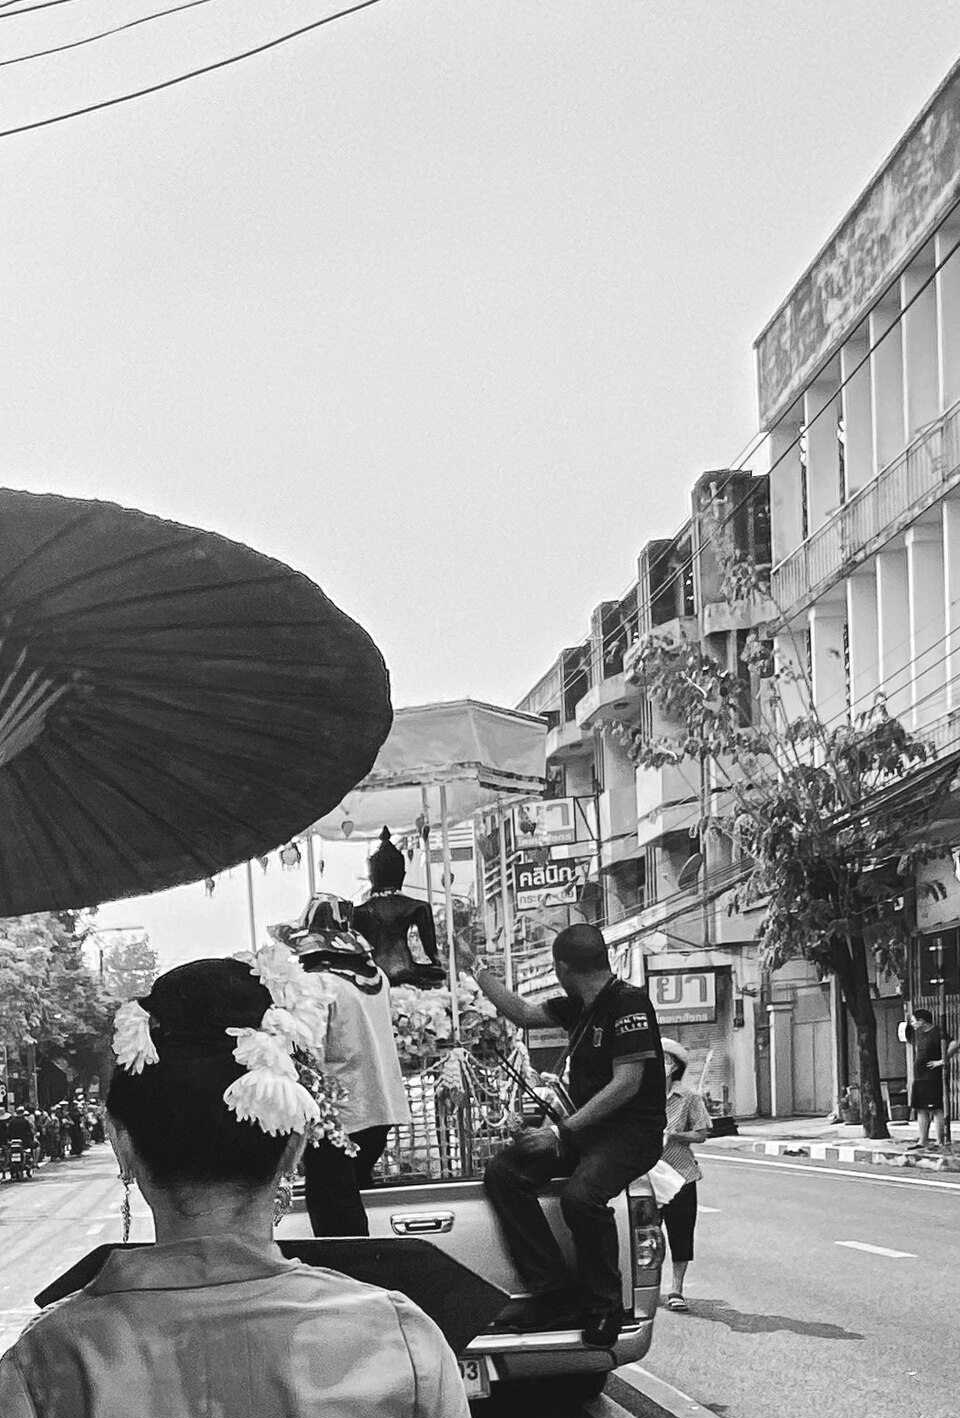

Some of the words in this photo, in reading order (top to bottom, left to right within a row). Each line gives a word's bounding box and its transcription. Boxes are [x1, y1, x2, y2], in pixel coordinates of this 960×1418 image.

[520, 865, 572, 888] คลินิก
[656, 975, 708, 1004] ยา
